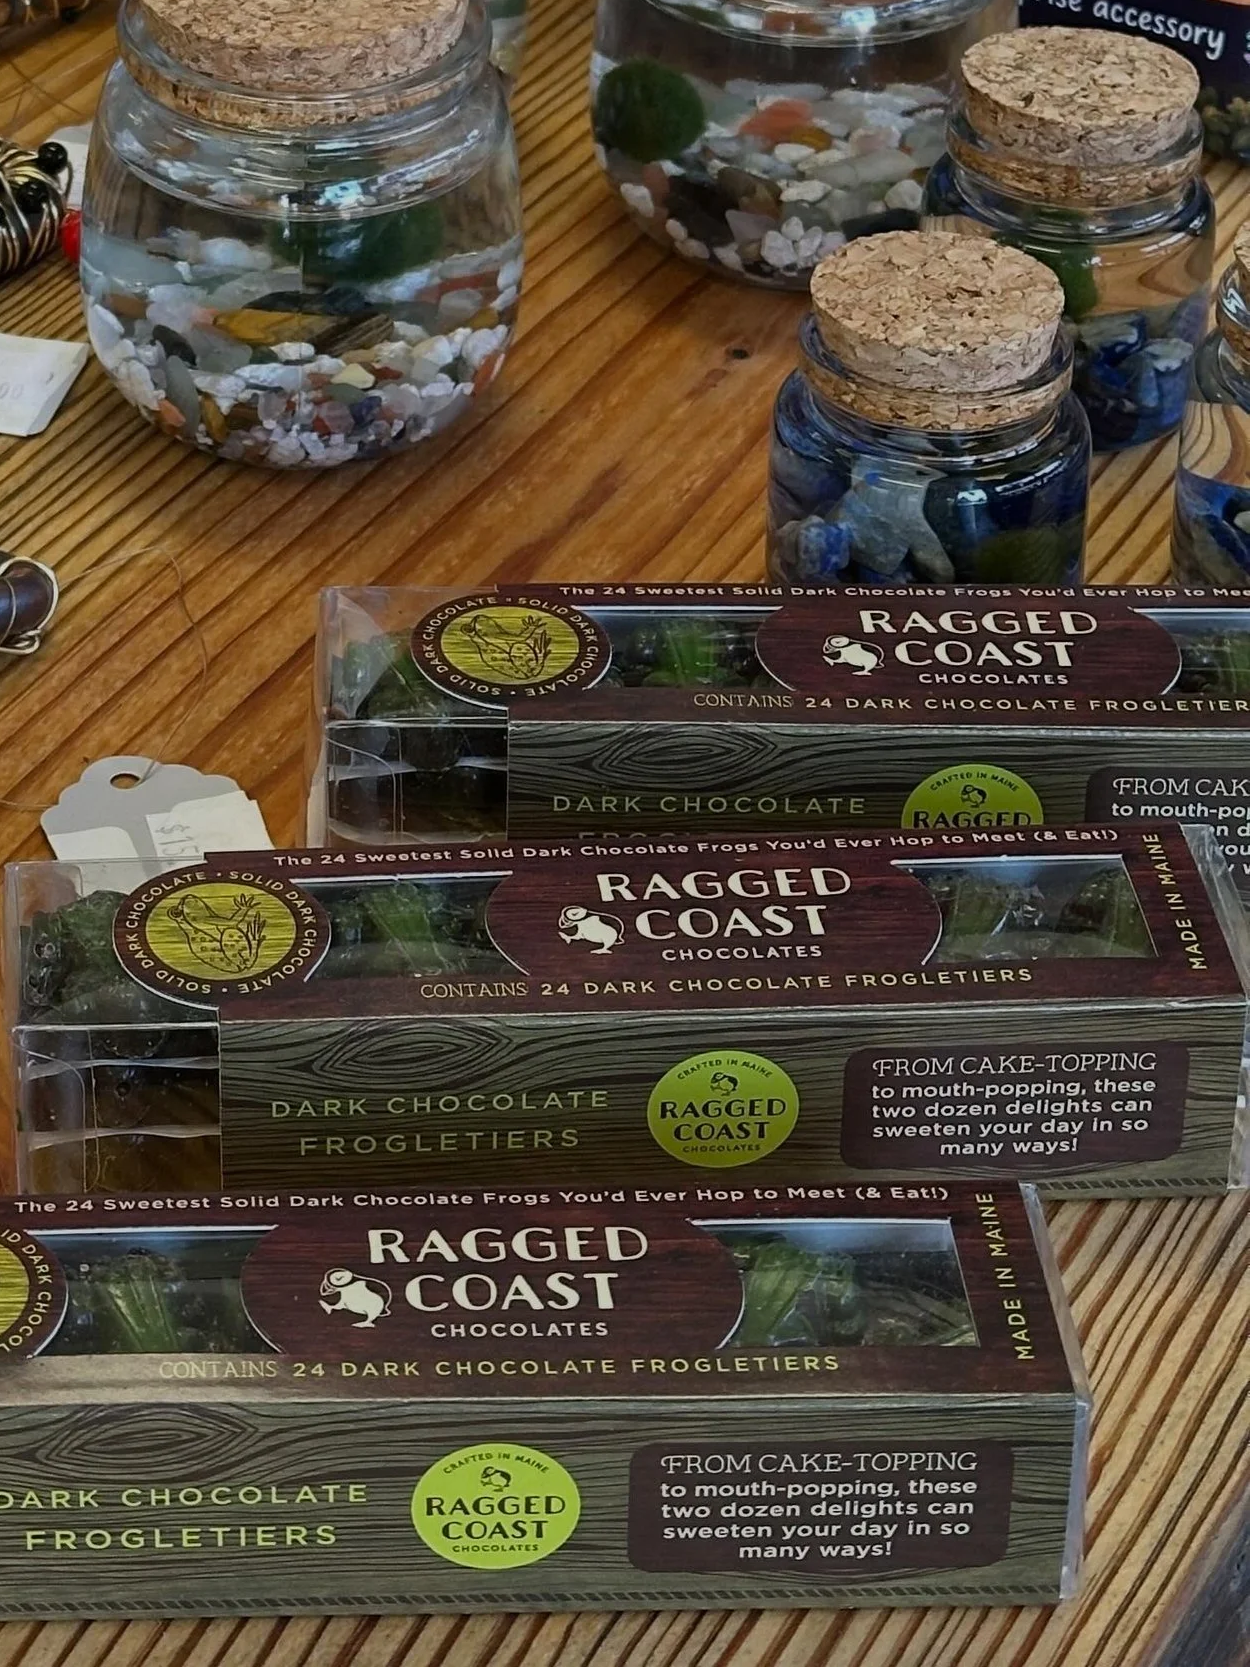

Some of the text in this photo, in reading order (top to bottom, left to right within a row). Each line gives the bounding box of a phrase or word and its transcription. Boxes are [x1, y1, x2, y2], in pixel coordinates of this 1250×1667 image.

[859, 609, 1098, 635] RAGGED
[893, 640, 1074, 667] COAST
[918, 672, 1069, 685] CHOCOLATES
[693, 693, 793, 709] CONTAINS
[805, 697, 832, 709] 24
[845, 698, 912, 710] DARK
[924, 698, 1077, 711] CHOCOLATE
[1113, 778, 1191, 796] FROM
[553, 795, 866, 815] DARK CHOCOLATE
[1112, 803, 1133, 817] to
[595, 867, 852, 903] RAGGED
[1143, 833, 1208, 971] MADE IN MAINE
[635, 904, 828, 941] COAST
[661, 944, 823, 962] CHOCOLATES
[420, 967, 1033, 1000] CONTAINS 24 DARK CHOCOLATE FROGLETIERS
[872, 1052, 1157, 1078] FROM CAKE-TOPPING
[872, 1077, 1157, 1099] to mouth-popping, these
[271, 1089, 610, 1119] DARK CHOCOLATE
[660, 1098, 787, 1119] RAGGED
[872, 1098, 1154, 1119] two dozen delights can
[674, 1122, 770, 1141] COAST
[872, 1117, 1149, 1138] sweeten your day in so
[300, 1129, 581, 1157] FROGLETIERS
[682, 1144, 761, 1153] CHOCOLATES
[940, 1139, 1079, 1157] many ways!
[14, 1186, 949, 1213] The 24 Sweetest Solid Dark Chocolate Frogs You'd Ever Hop to Meet (& Eat!)
[367, 1226, 649, 1264] RAGGED
[975, 1192, 1036, 1362] MADE IN MAINE
[404, 1272, 619, 1312] COAST
[430, 1322, 609, 1339] CHOCOLATES
[159, 1355, 840, 1379] CONTAINS 24 DARK CHOCOLATE FROGLETIERS
[443, 1453, 494, 1474] CRAFTED
[515, 1455, 549, 1474] MAINE
[660, 1451, 978, 1475] FROM CAKE-TOPPING
[121, 1484, 368, 1508] CHOCOLATE
[660, 1478, 978, 1500] to mouth-popping, these
[426, 1496, 566, 1516] RAGGED
[661, 1499, 975, 1519] two dozen delights can
[26, 1524, 337, 1551] FROGLETIERS
[442, 1520, 549, 1540] COAST
[663, 1519, 970, 1541] sweeten your day in so
[452, 1544, 539, 1553] CHOCOLATES
[739, 1541, 894, 1562] many ways!
